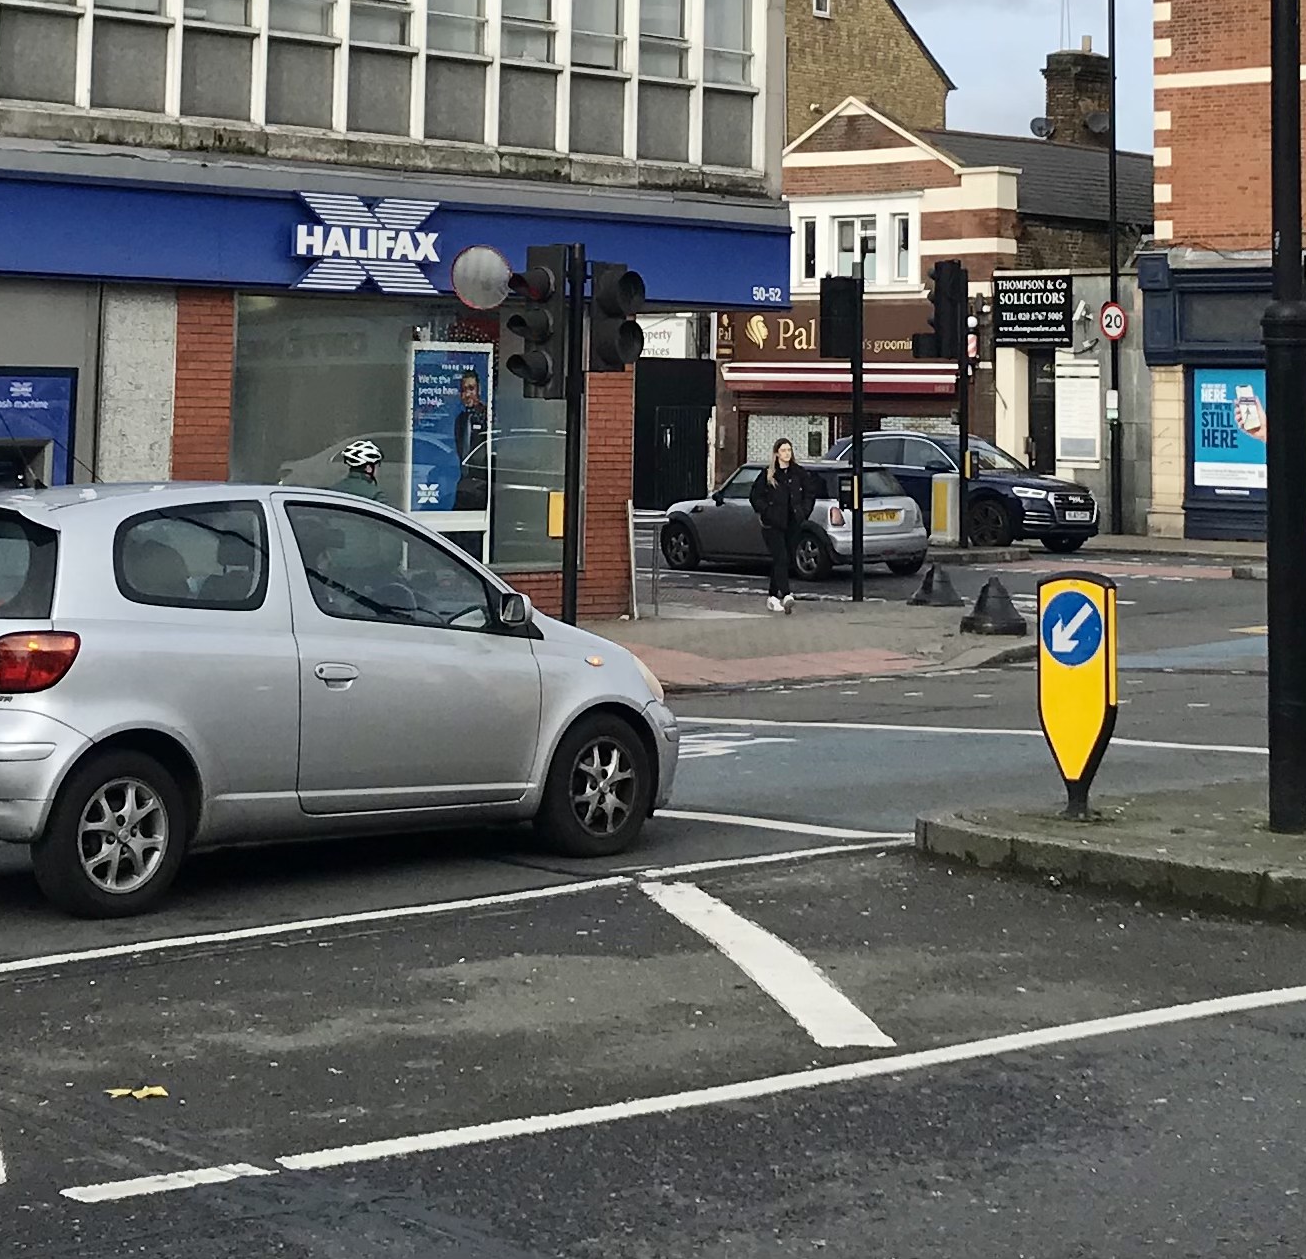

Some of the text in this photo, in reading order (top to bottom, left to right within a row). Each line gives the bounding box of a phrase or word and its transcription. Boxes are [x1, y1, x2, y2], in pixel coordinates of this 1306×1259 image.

[296, 224, 440, 262] HALIFAX
[997, 279, 1067, 290] THOMPSON & Co
[752, 286, 782, 302] 50-52
[999, 292, 1065, 305] SOLICITORS
[1104, 314, 1123, 329] 20
[642, 330, 672, 344] operty
[642, 345, 670, 356] rvices
[873, 337, 913, 353] groomi
[1201, 411, 1234, 428] STILL
[1201, 429, 1239, 448] HERE
